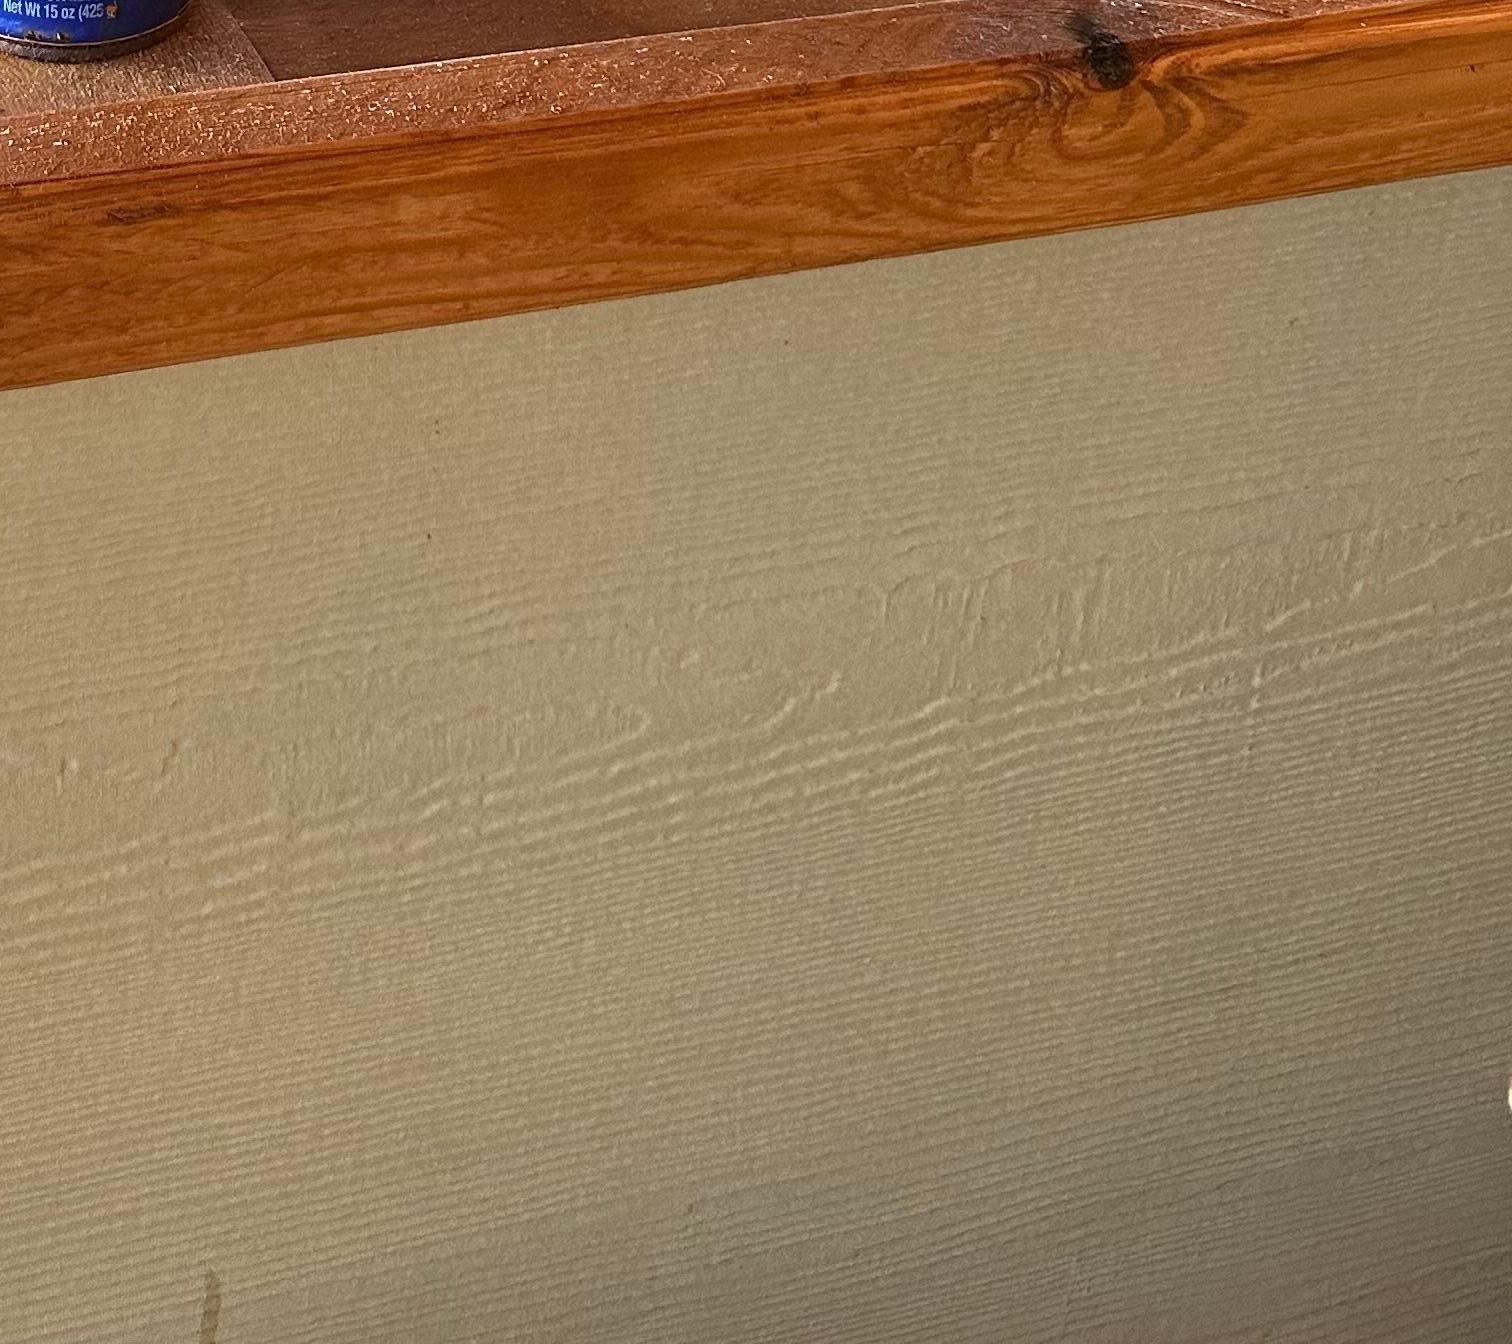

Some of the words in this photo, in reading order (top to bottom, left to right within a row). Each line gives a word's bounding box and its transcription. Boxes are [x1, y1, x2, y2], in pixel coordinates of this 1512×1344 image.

[24, 0, 41, 18] Wt
[43, 3, 59, 19] 15
[60, 7, 76, 20] oz
[78, 2, 104, 22] (425
